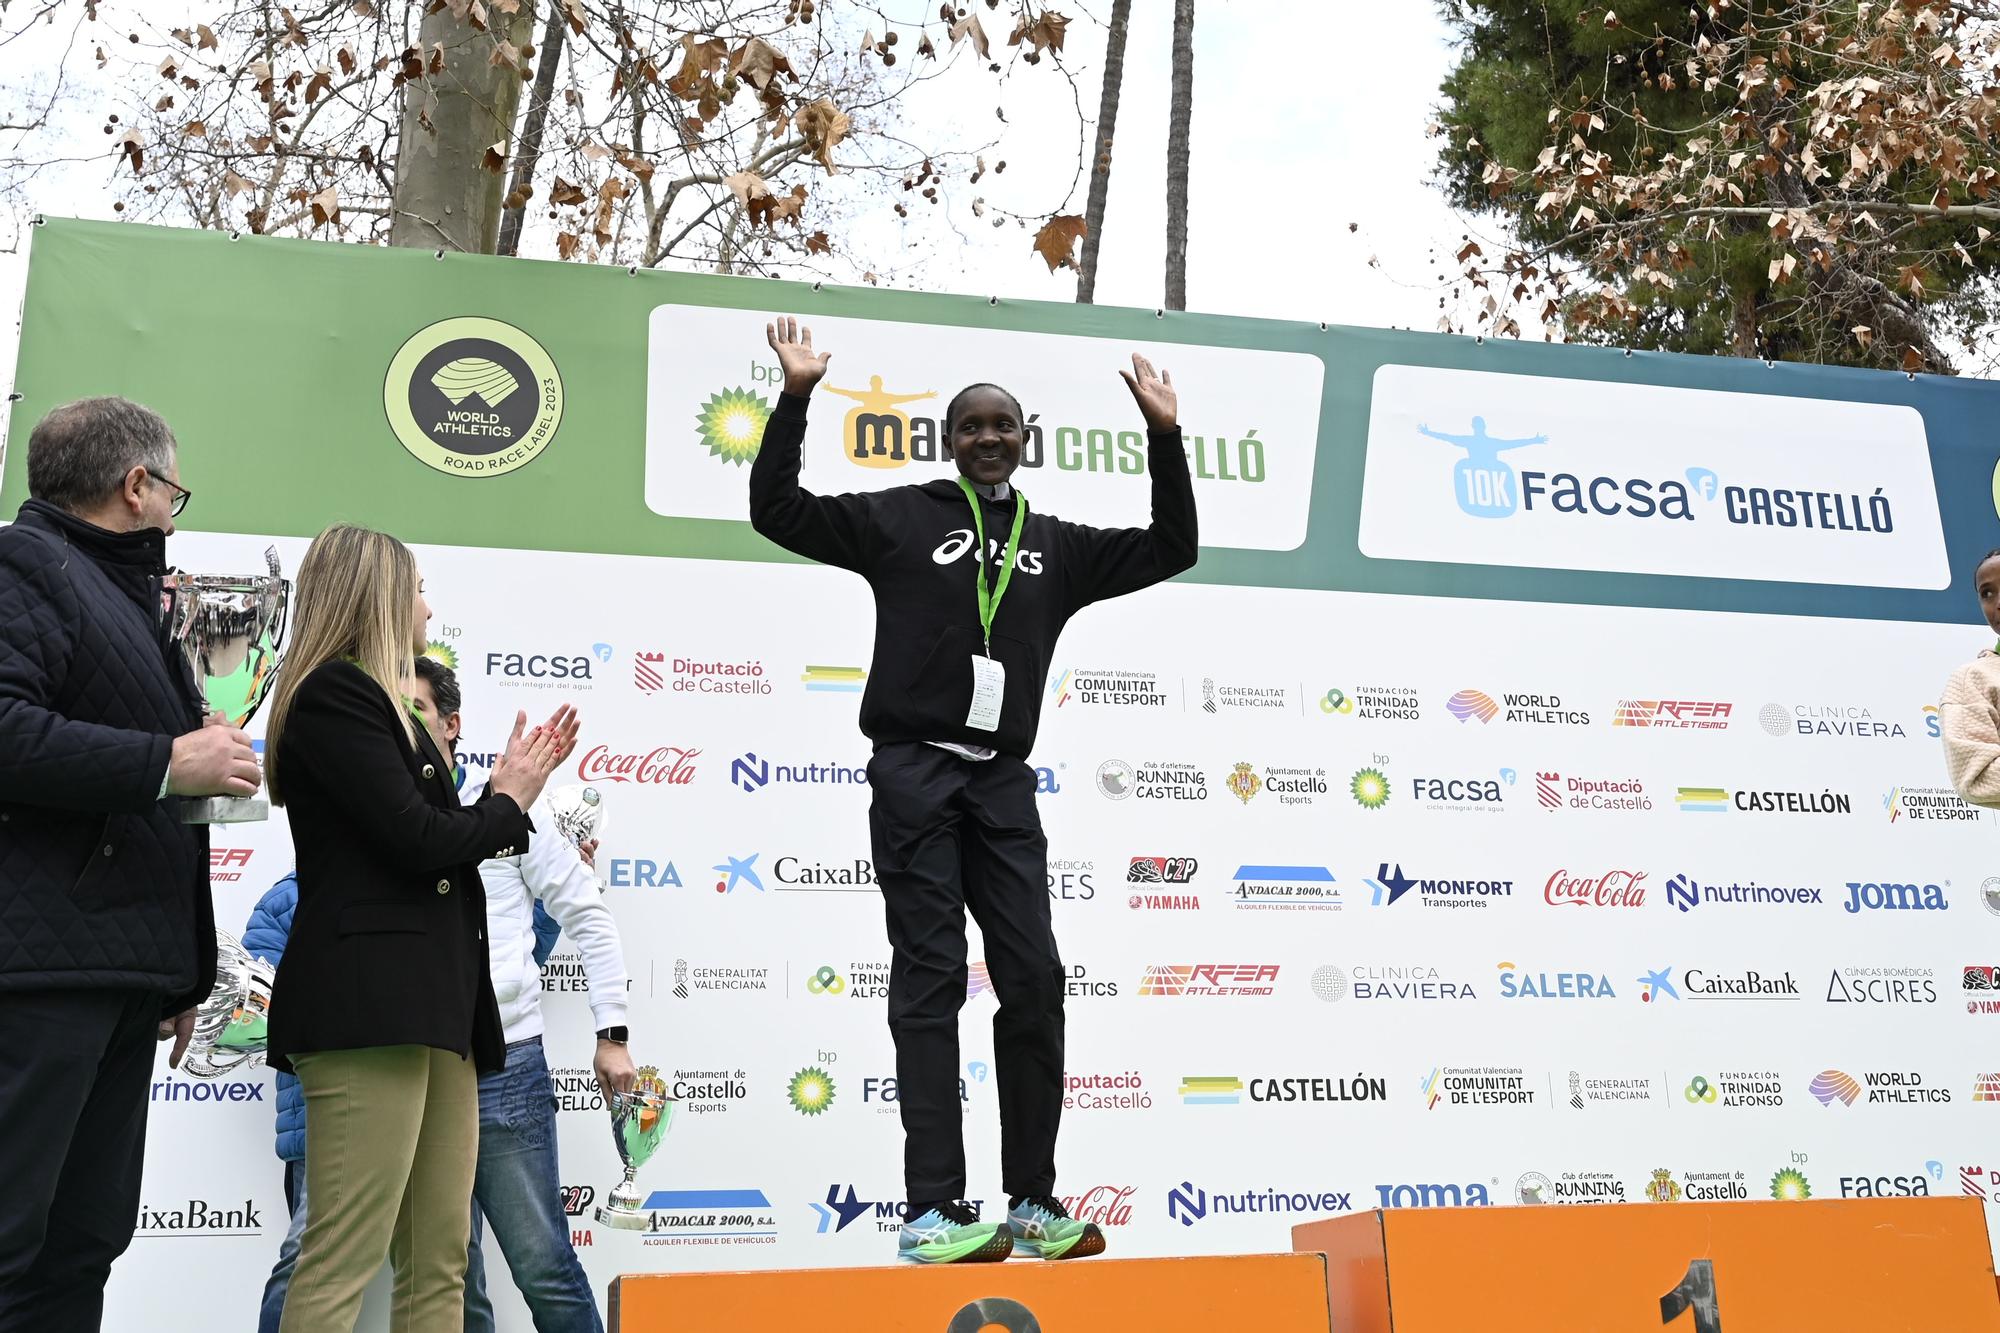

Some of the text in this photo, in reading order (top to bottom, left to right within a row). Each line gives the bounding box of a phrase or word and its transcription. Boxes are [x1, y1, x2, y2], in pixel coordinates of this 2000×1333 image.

[752, 360, 783, 387] bp
[444, 378, 556, 470] ROAD RACE LABEL 2023
[447, 411, 499, 423] WORLD
[434, 423, 512, 437] ATHLETICS
[1056, 427, 1265, 482] CASLLÓ
[1462, 467, 1894, 534] 10K Facsa CASTELLÓ
[974, 539, 1043, 574] acs
[442, 624, 461, 639] bp
[487, 653, 592, 680] Facsa
[673, 659, 762, 677] Diputació
[1075, 669, 1156, 679] Comunitat Valenciana
[523, 680, 554, 689] integral
[557, 682, 570, 690] del
[673, 678, 771, 695] de Castelló
[1075, 679, 1156, 692] COMUNITAT
[1219, 687, 1285, 697] GENERALITAT
[1356, 686, 1417, 695] FUNDACIÓN
[1082, 691, 1166, 706] DE L'ESPORT
[1221, 698, 1284, 707] VALENCIANA
[1357, 696, 1418, 708] TRINIDAD
[1503, 694, 1560, 708] WORLD
[1359, 709, 1419, 720] ALFONSO
[1656, 700, 1733, 719] RFEA
[1796, 705, 1871, 719] CLINICA
[1506, 710, 1590, 725] ATHLETICS
[1654, 719, 1728, 730] ATLETISMO
[1798, 720, 1906, 738] BAVIERA
[578, 744, 703, 784] Coca-Cola
[1373, 752, 1389, 766] bp
[776, 762, 868, 784] nutrino
[1137, 770, 1205, 784] RUNNING
[1265, 766, 1325, 776] Ajuntament de
[1137, 783, 1207, 800] CASTELLÓ
[1266, 777, 1327, 793] Castelló
[1413, 779, 1502, 802] Facsa
[1568, 778, 1642, 796] Diputació
[1901, 786, 1933, 794] Comunitat
[1280, 795, 1312, 805] Esports
[1570, 794, 1652, 810] de Castelló
[1735, 789, 1851, 814] CASTELLÓN
[1909, 808, 1980, 820] DE L'ESPORT
[774, 857, 879, 885] CaixaB
[1048, 860, 1093, 870] MÉDICAS
[1163, 858, 1197, 882] C2P
[611, 859, 682, 887] ERA
[1235, 881, 1292, 898] ANDACAR
[1296, 887, 1324, 897] 2000,
[1420, 880, 1512, 896] MONFORT
[1544, 869, 1649, 907] Coca-Cola
[1705, 882, 1822, 904] nutrinovex
[1144, 896, 1200, 909] YAMAHA
[1422, 898, 1486, 909] Transportes
[693, 969, 768, 978] GENERALITAT
[851, 962, 889, 970] FUNDA
[1353, 967, 1439, 980] CLINICA
[1845, 968, 1933, 976] CLÍNICAS BIOMÉDICAS
[850, 974, 889, 985] TRINI
[1190, 965, 1280, 986] RFEA
[1684, 970, 1799, 994] CaixaBank
[694, 981, 766, 990] VALENCIANA
[851, 987, 888, 998] ALFO
[1064, 983, 1118, 996] ETICS
[1186, 987, 1273, 996] ATLETISMO
[1354, 983, 1476, 999] BAVIERA
[1501, 973, 1616, 998] SALERA
[1826, 970, 1936, 1003] ASCIRES
[818, 1049, 836, 1064] bp
[674, 1070, 746, 1080] Ajuntament de
[1063, 1073, 1141, 1092] iputació
[1865, 1072, 1921, 1086] WORLD
[152, 1076, 264, 1101] rinovex
[553, 1078, 600, 1092] NING
[673, 1081, 746, 1098] Castelló
[1250, 1073, 1386, 1101] CASTELLÓN
[1444, 1078, 1523, 1089] COMUNITAT
[1586, 1079, 1649, 1089] GENERALITAT
[1720, 1082, 1781, 1093] TRINIDAD
[556, 1092, 602, 1111] ELLÓ
[1063, 1092, 1152, 1109] e Castelló
[1451, 1092, 1534, 1104] DE L'ESPORT
[1588, 1091, 1650, 1099] VALENCIANA
[1724, 1096, 1782, 1106] ALFONSO
[1869, 1089, 1951, 1102] ATHLETICS
[689, 1103, 726, 1114] Esports
[1791, 1150, 1808, 1165] bp
[1684, 1171, 1744, 1182] Ajuntament de
[1555, 1181, 1624, 1196] RUNNING
[1686, 1182, 1747, 1200] Castelló
[1840, 1175, 1928, 1198] Facsa
[1214, 1188, 1351, 1213] nutrinovex
[135, 1200, 262, 1229] ixaBank
[648, 1211, 715, 1232] ANDACAR
[720, 1216, 754, 1227] 2000,
[734, 1236, 776, 1244] VEHÍCULOS
[1659, 1259, 1721, 1333] 1
